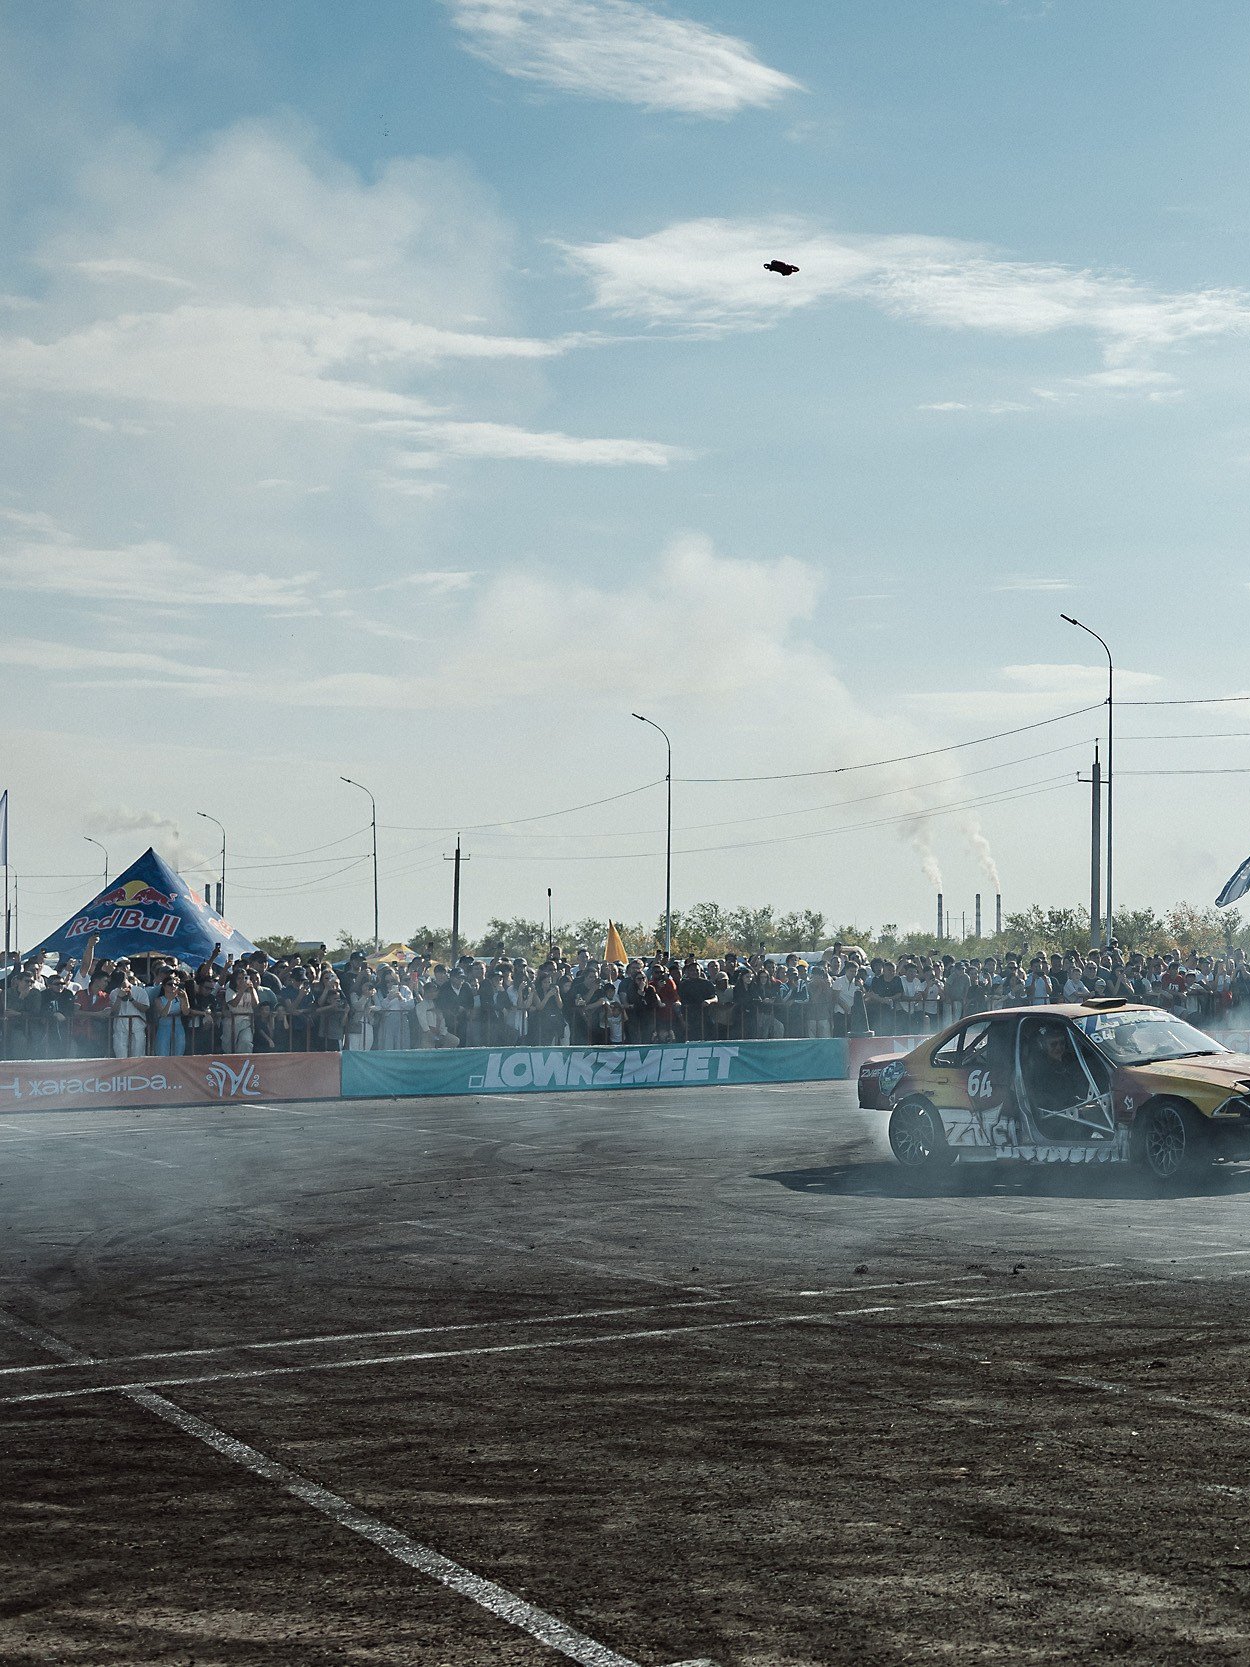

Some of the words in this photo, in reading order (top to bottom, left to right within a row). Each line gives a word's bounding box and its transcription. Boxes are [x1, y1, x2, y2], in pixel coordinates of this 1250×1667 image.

[65, 907, 119, 938] Red
[117, 908, 182, 937] Bull
[967, 1069, 993, 1098] 64
